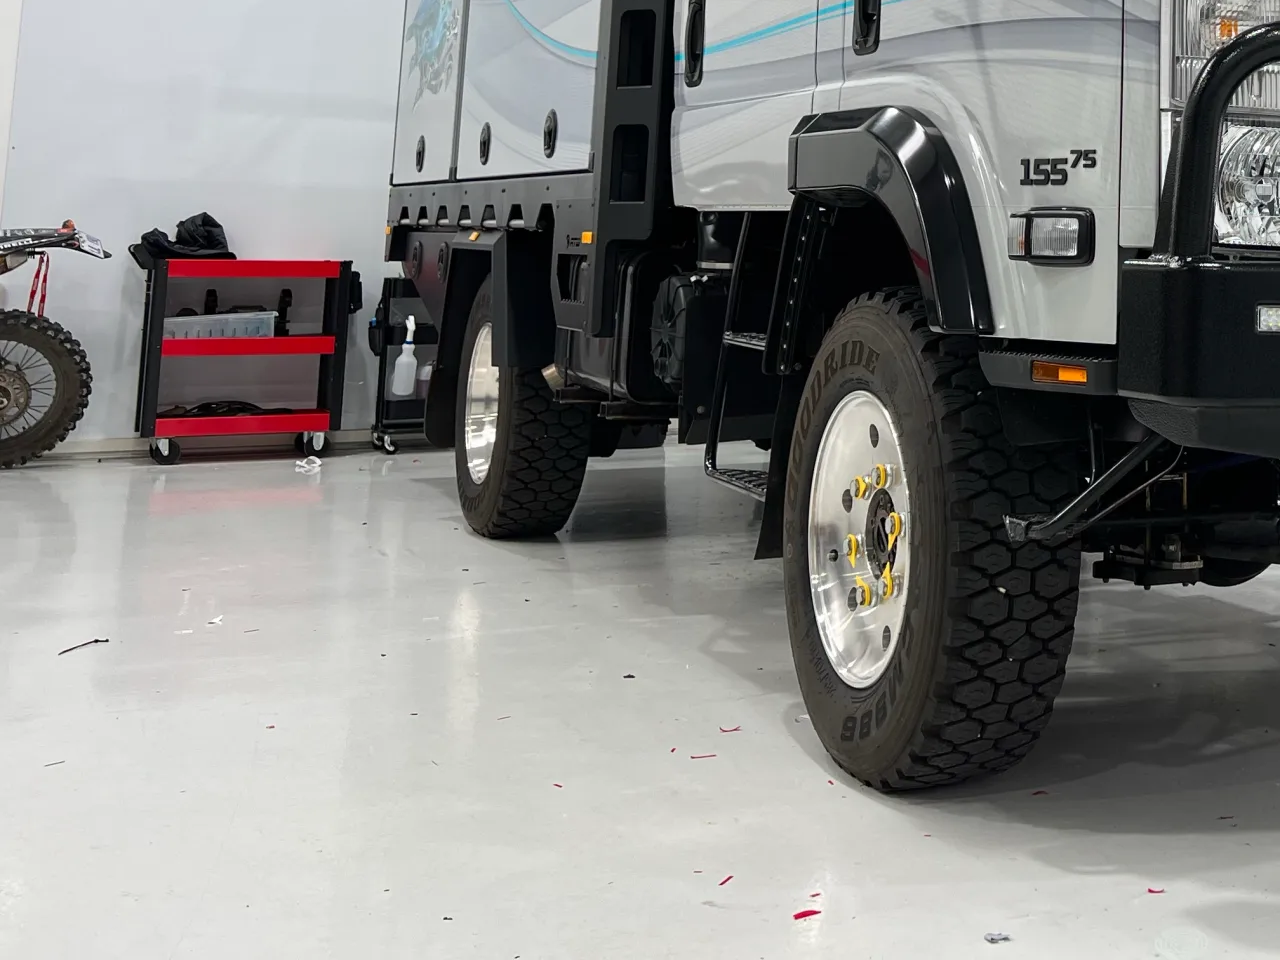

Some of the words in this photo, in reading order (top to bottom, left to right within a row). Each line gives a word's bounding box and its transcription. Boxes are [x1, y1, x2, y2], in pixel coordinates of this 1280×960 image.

[1019, 157, 1069, 186] 155
[1070, 148, 1098, 169] 75
[786, 339, 882, 510] GOODRIDE
